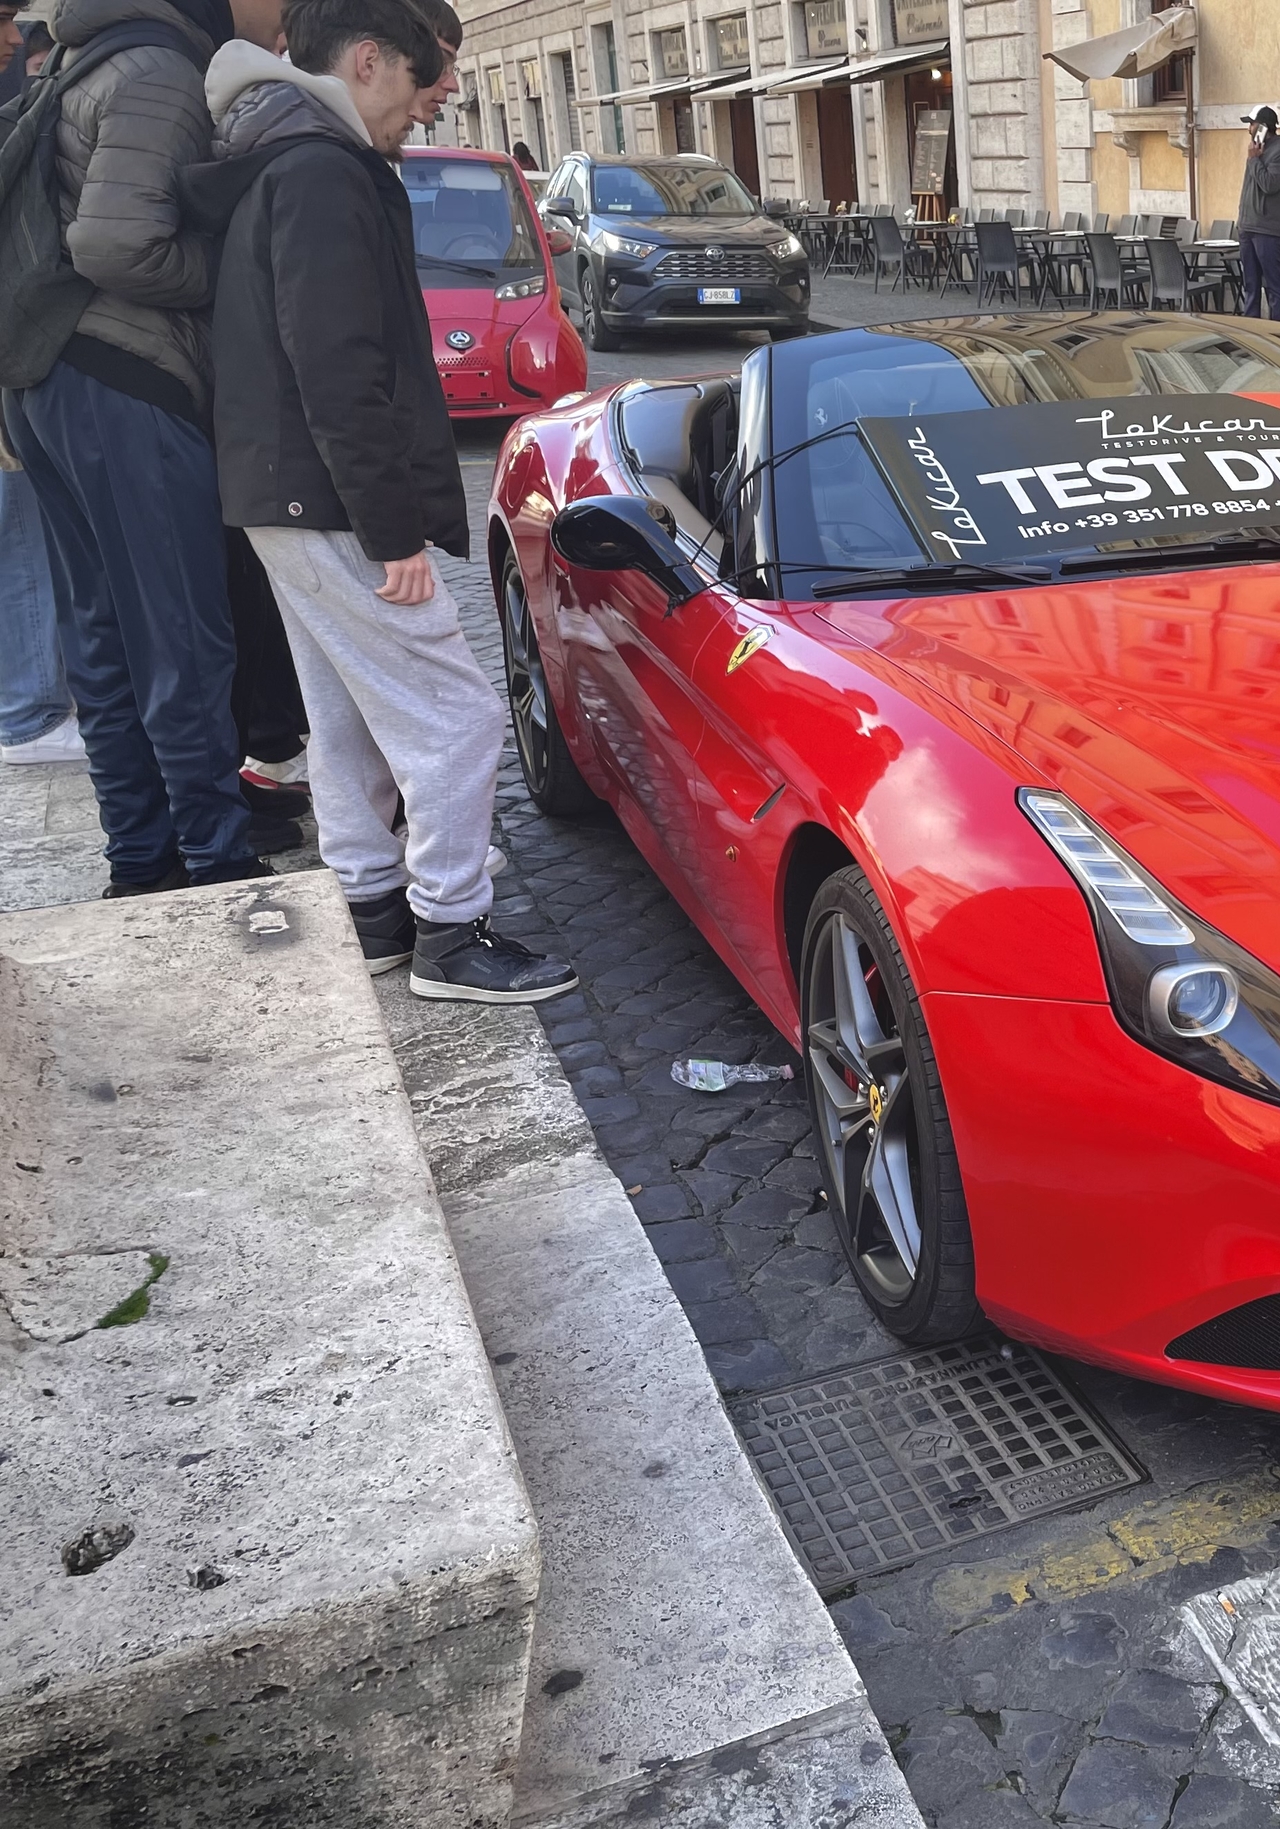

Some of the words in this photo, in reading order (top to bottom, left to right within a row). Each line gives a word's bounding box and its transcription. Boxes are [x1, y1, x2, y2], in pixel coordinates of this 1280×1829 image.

[1101, 437, 1202, 450] TESTDRIVE
[1216, 435, 1225, 443] &
[976, 452, 1189, 514] TEST
[1017, 521, 1070, 539] Info
[1074, 512, 1118, 528] +39
[1122, 507, 1165, 523] 351
[1165, 503, 1210, 518] 778
[1211, 499, 1271, 514] 8854
[764, 1393, 863, 1430] PUBBLICA
